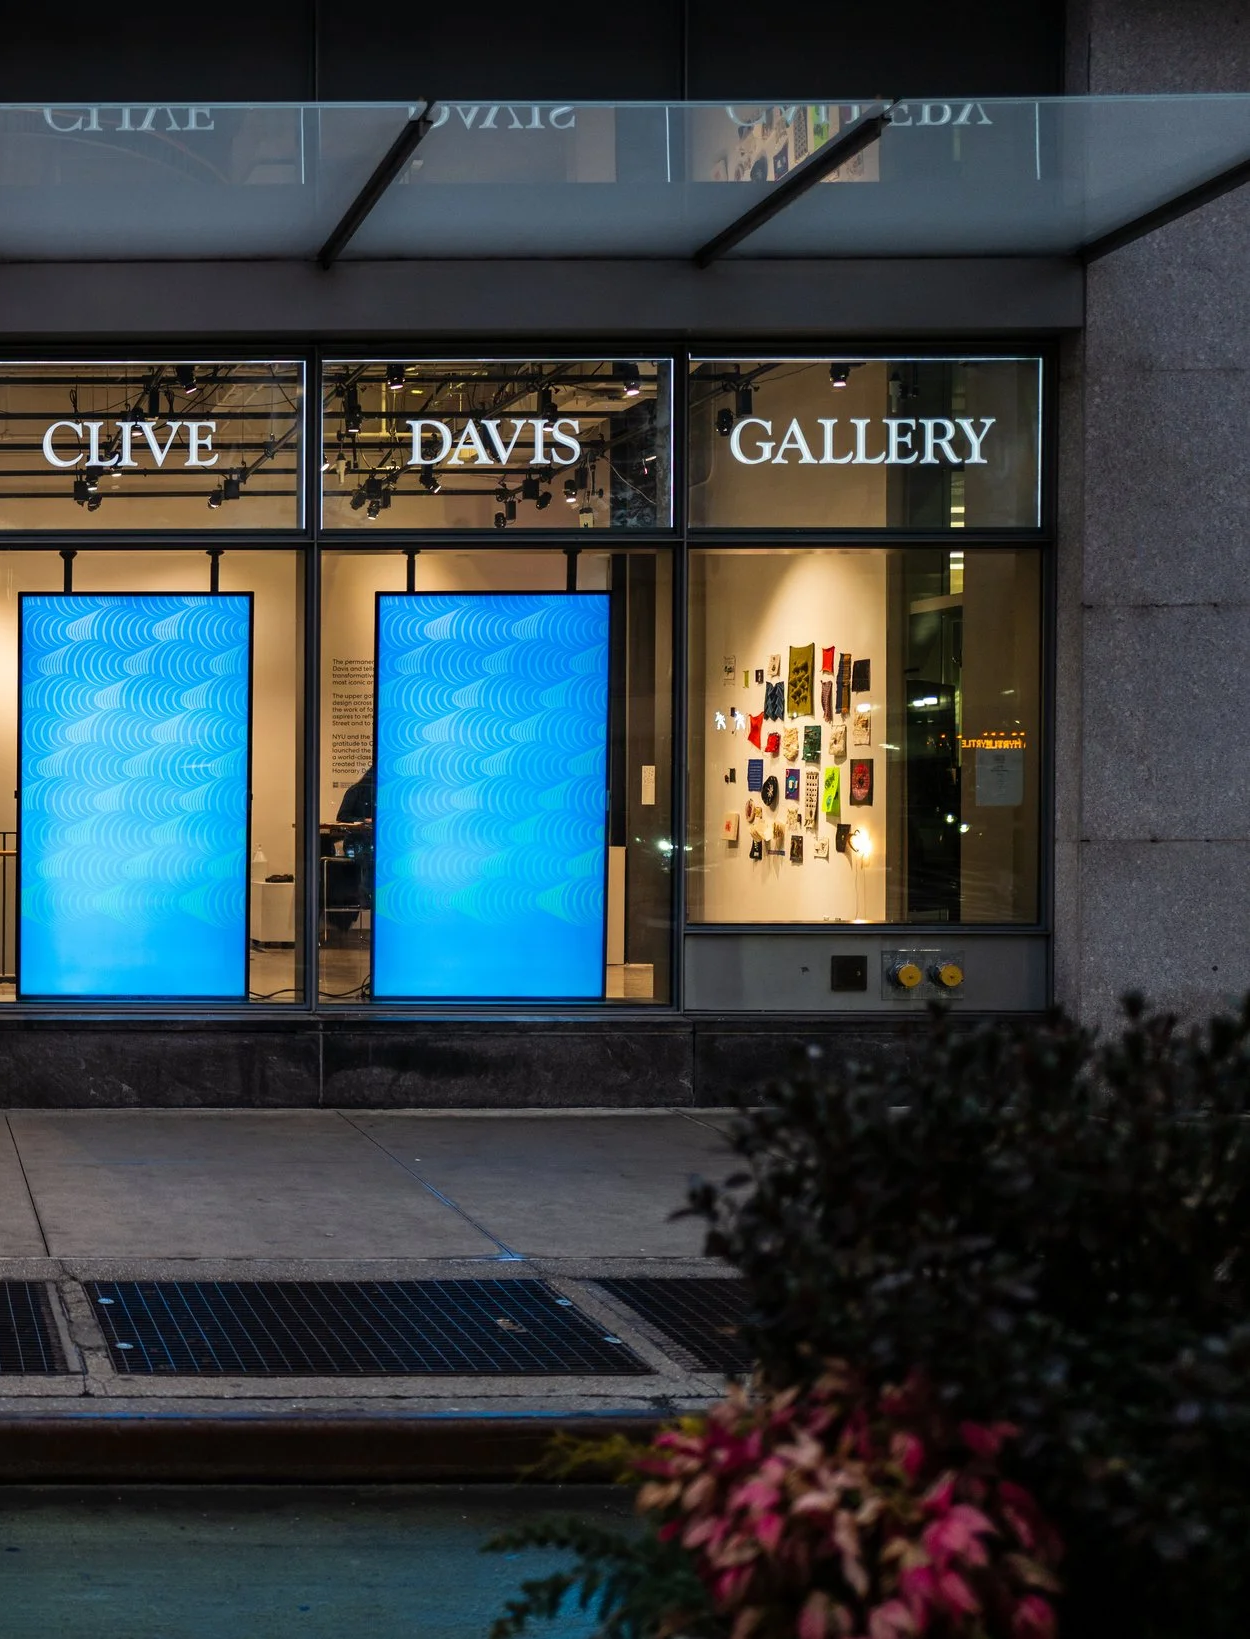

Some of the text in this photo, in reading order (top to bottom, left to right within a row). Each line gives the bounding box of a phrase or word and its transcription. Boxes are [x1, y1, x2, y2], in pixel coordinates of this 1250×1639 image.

[43, 419, 995, 467] CLIVE DAVIS GALLERY
[333, 699, 352, 707] design
[332, 740, 360, 748] gratitude
